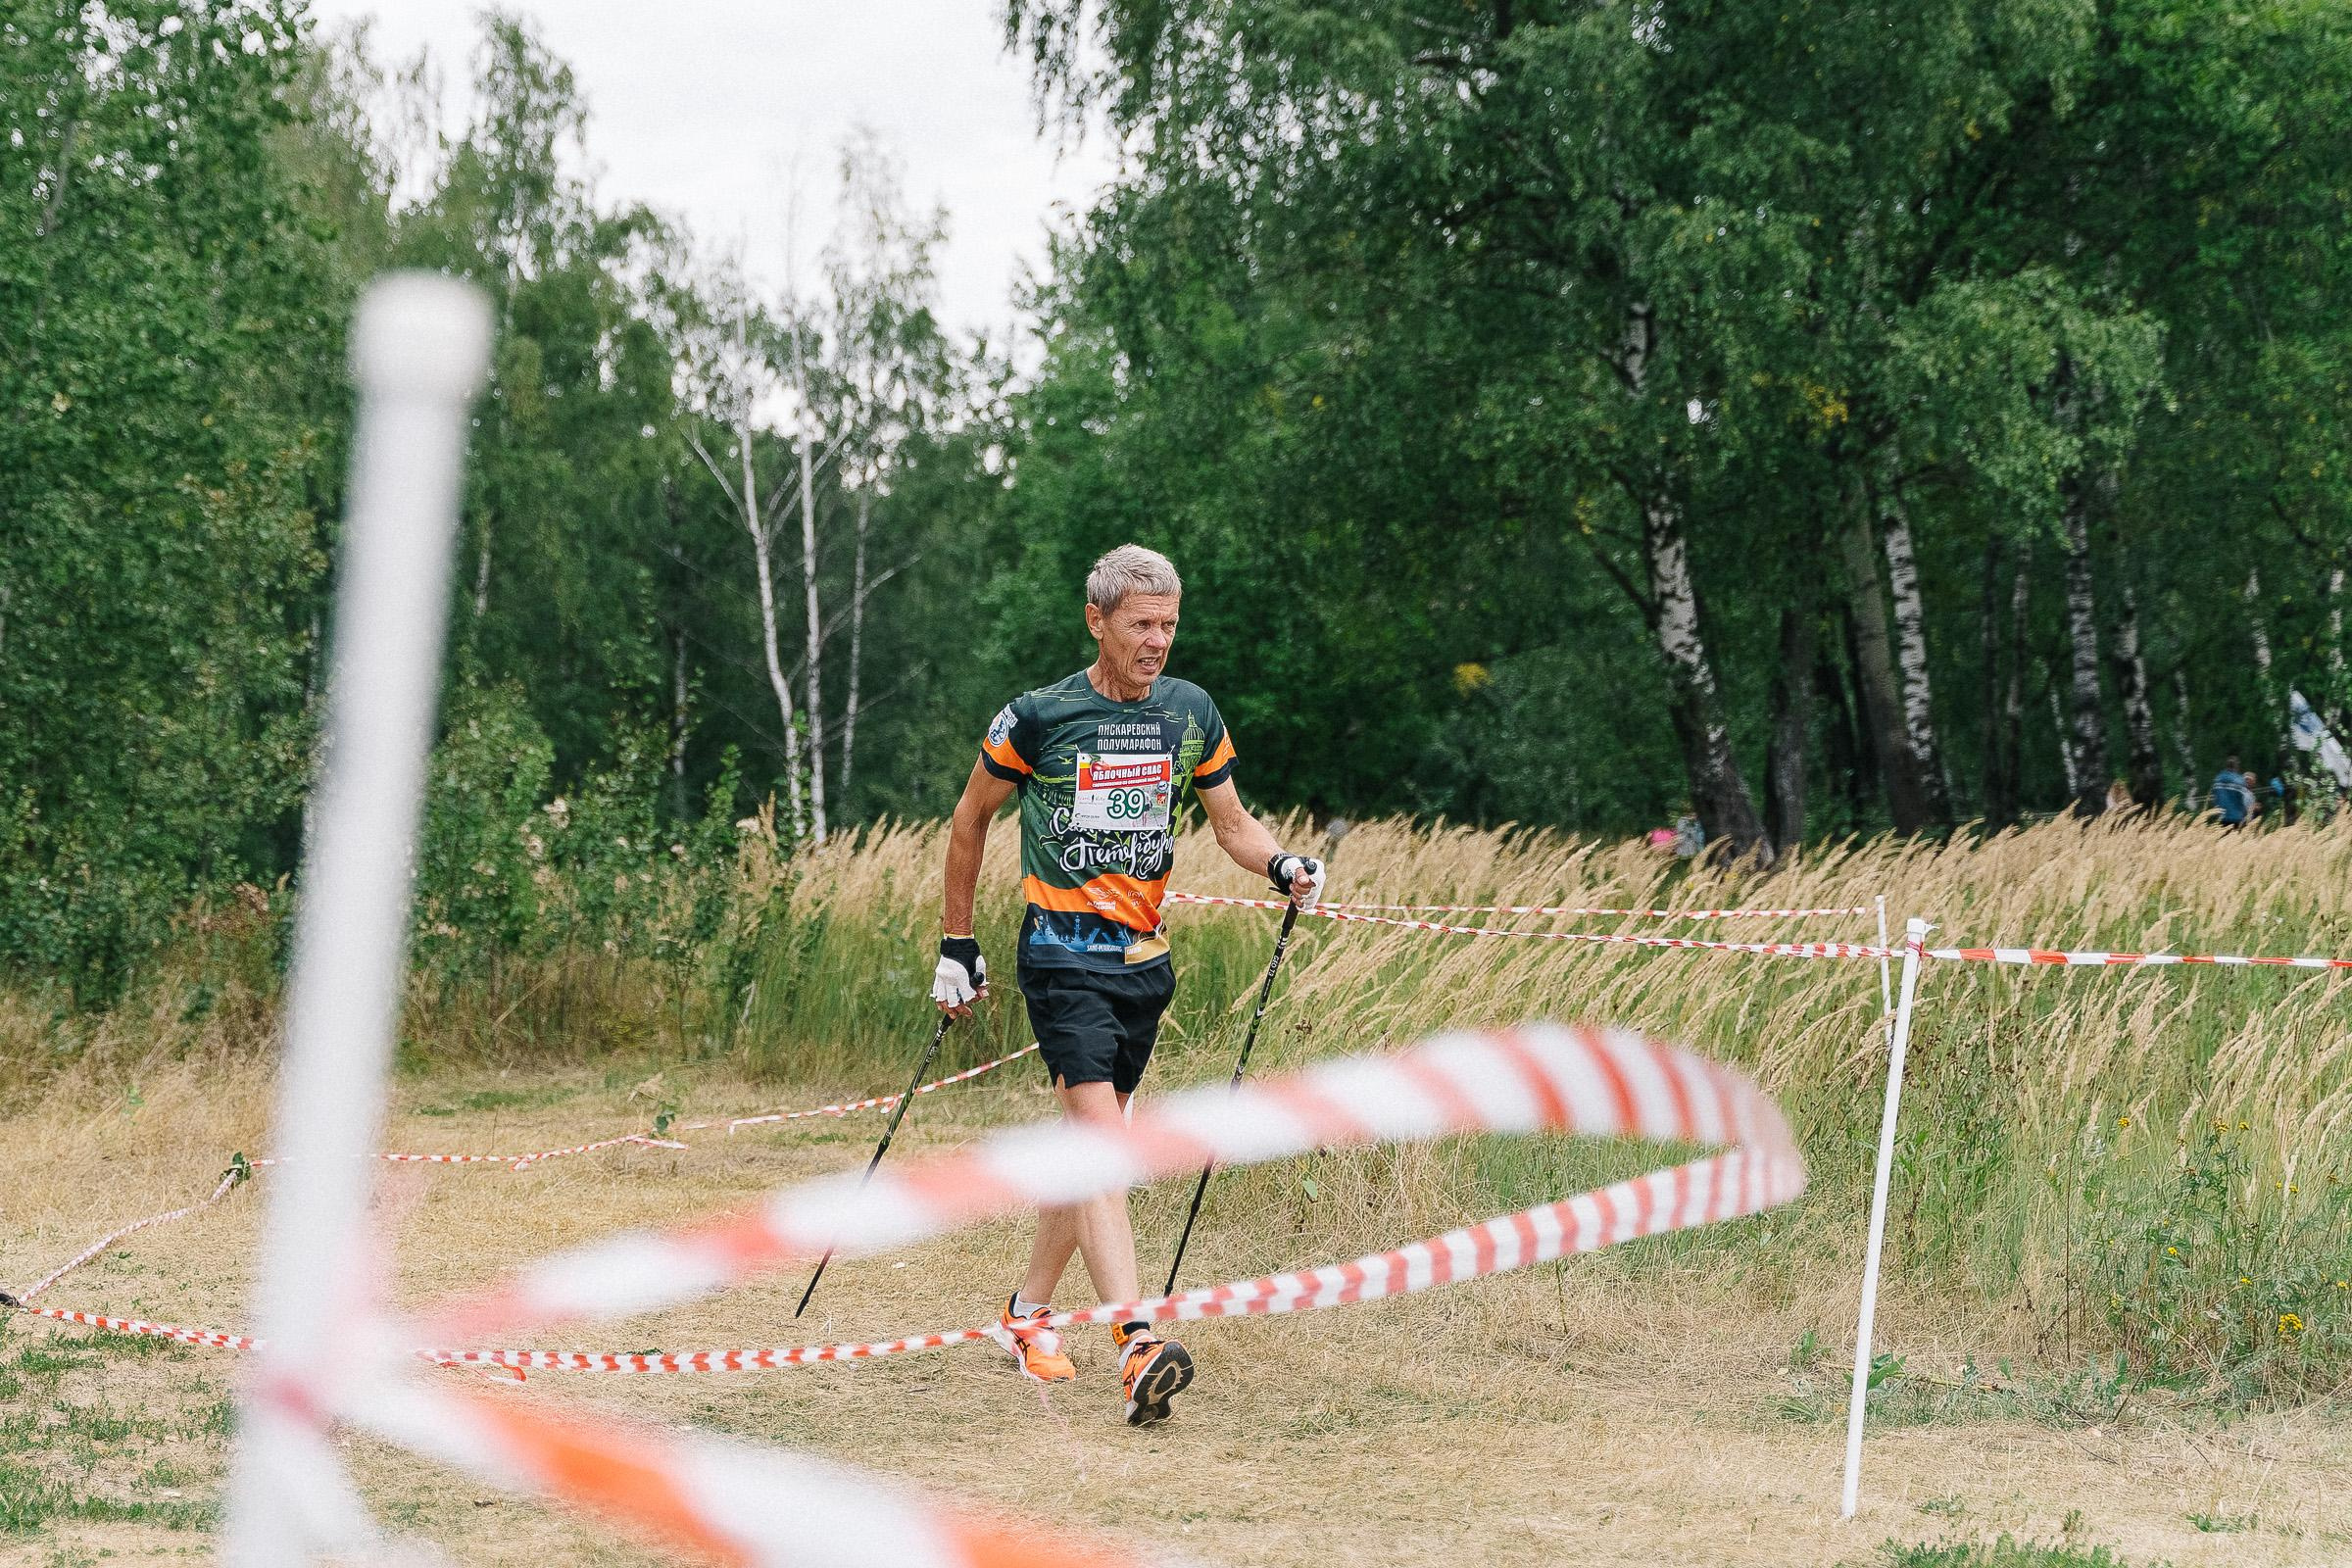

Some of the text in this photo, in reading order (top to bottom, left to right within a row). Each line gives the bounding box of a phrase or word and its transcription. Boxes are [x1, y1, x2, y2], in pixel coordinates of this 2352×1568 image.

[1098, 722, 1161, 736] ПИСКАРЕВСКИЙ
[1097, 738, 1162, 751] ПОЛУМАРАФОН
[1093, 764, 1162, 781] ЯБЛОЧНЫЙ СПАС
[1106, 788, 1146, 819] 39
